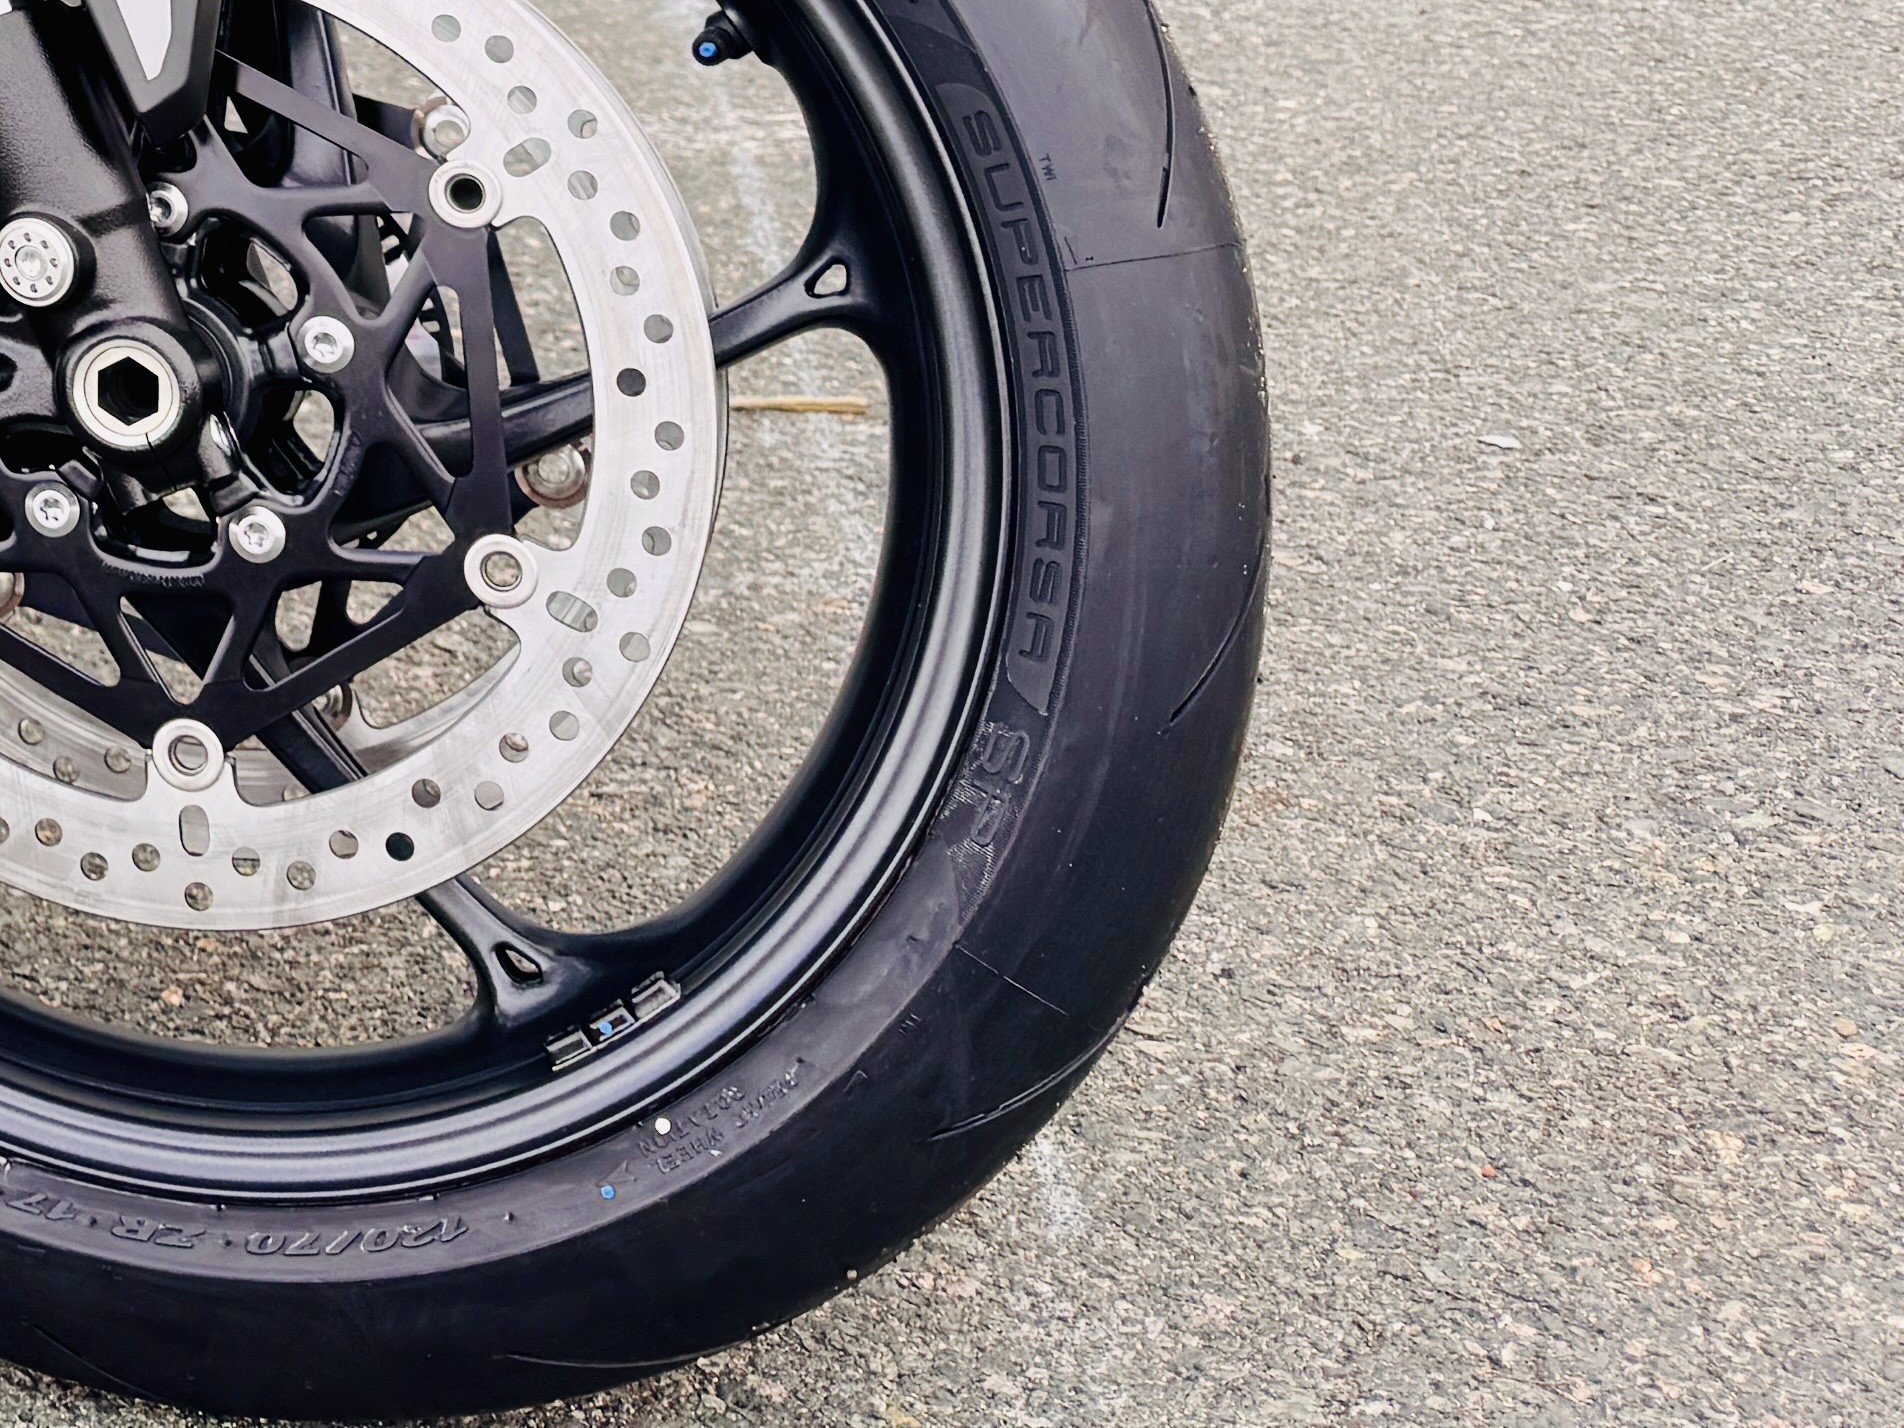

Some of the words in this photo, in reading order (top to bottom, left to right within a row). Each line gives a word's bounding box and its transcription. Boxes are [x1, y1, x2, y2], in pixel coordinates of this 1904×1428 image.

[1039, 153, 1056, 182] TWI
[960, 108, 1075, 663] SUPERCORSA
[969, 721, 1028, 847] SP
[3, 1182, 78, 1227] 17
[108, 1212, 207, 1251] ZR
[243, 1212, 471, 1258] 120/70
